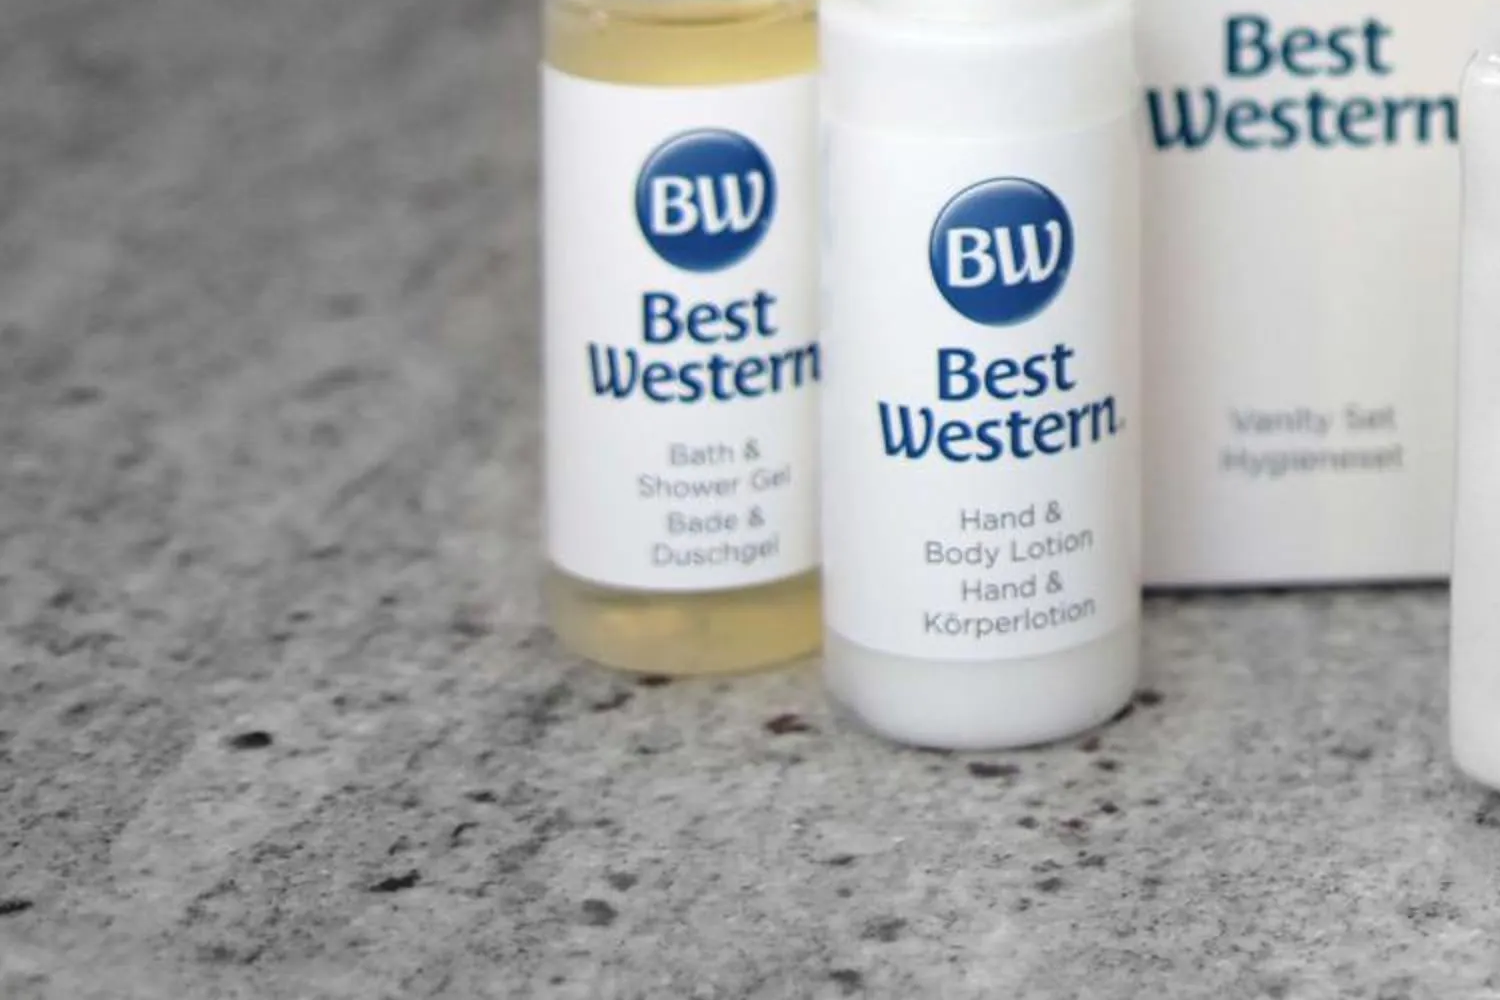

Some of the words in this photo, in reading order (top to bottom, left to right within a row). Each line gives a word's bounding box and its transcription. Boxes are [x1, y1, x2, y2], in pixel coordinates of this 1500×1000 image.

[1224, 12, 1392, 78] Best
[1145, 85, 1460, 151] Western
[650, 171, 765, 236] BW
[946, 219, 1062, 288] BW
[642, 291, 777, 344] Best
[588, 341, 822, 403] Western
[937, 343, 1076, 401] Best
[669, 441, 733, 467] Bath
[743, 438, 761, 461] &
[878, 394, 1119, 463] Western
[636, 472, 740, 499] Shower
[751, 464, 792, 491] Gel
[667, 509, 738, 536] Bade
[747, 505, 766, 529] &
[959, 503, 1035, 532] Hand
[1044, 500, 1063, 524] &
[651, 536, 780, 567] Duschgel
[925, 540, 999, 570] Body
[1011, 527, 1094, 563] Lotion
[961, 573, 1037, 602] Hand
[1045, 570, 1064, 594] &
[923, 597, 1097, 640] Körperlotion
